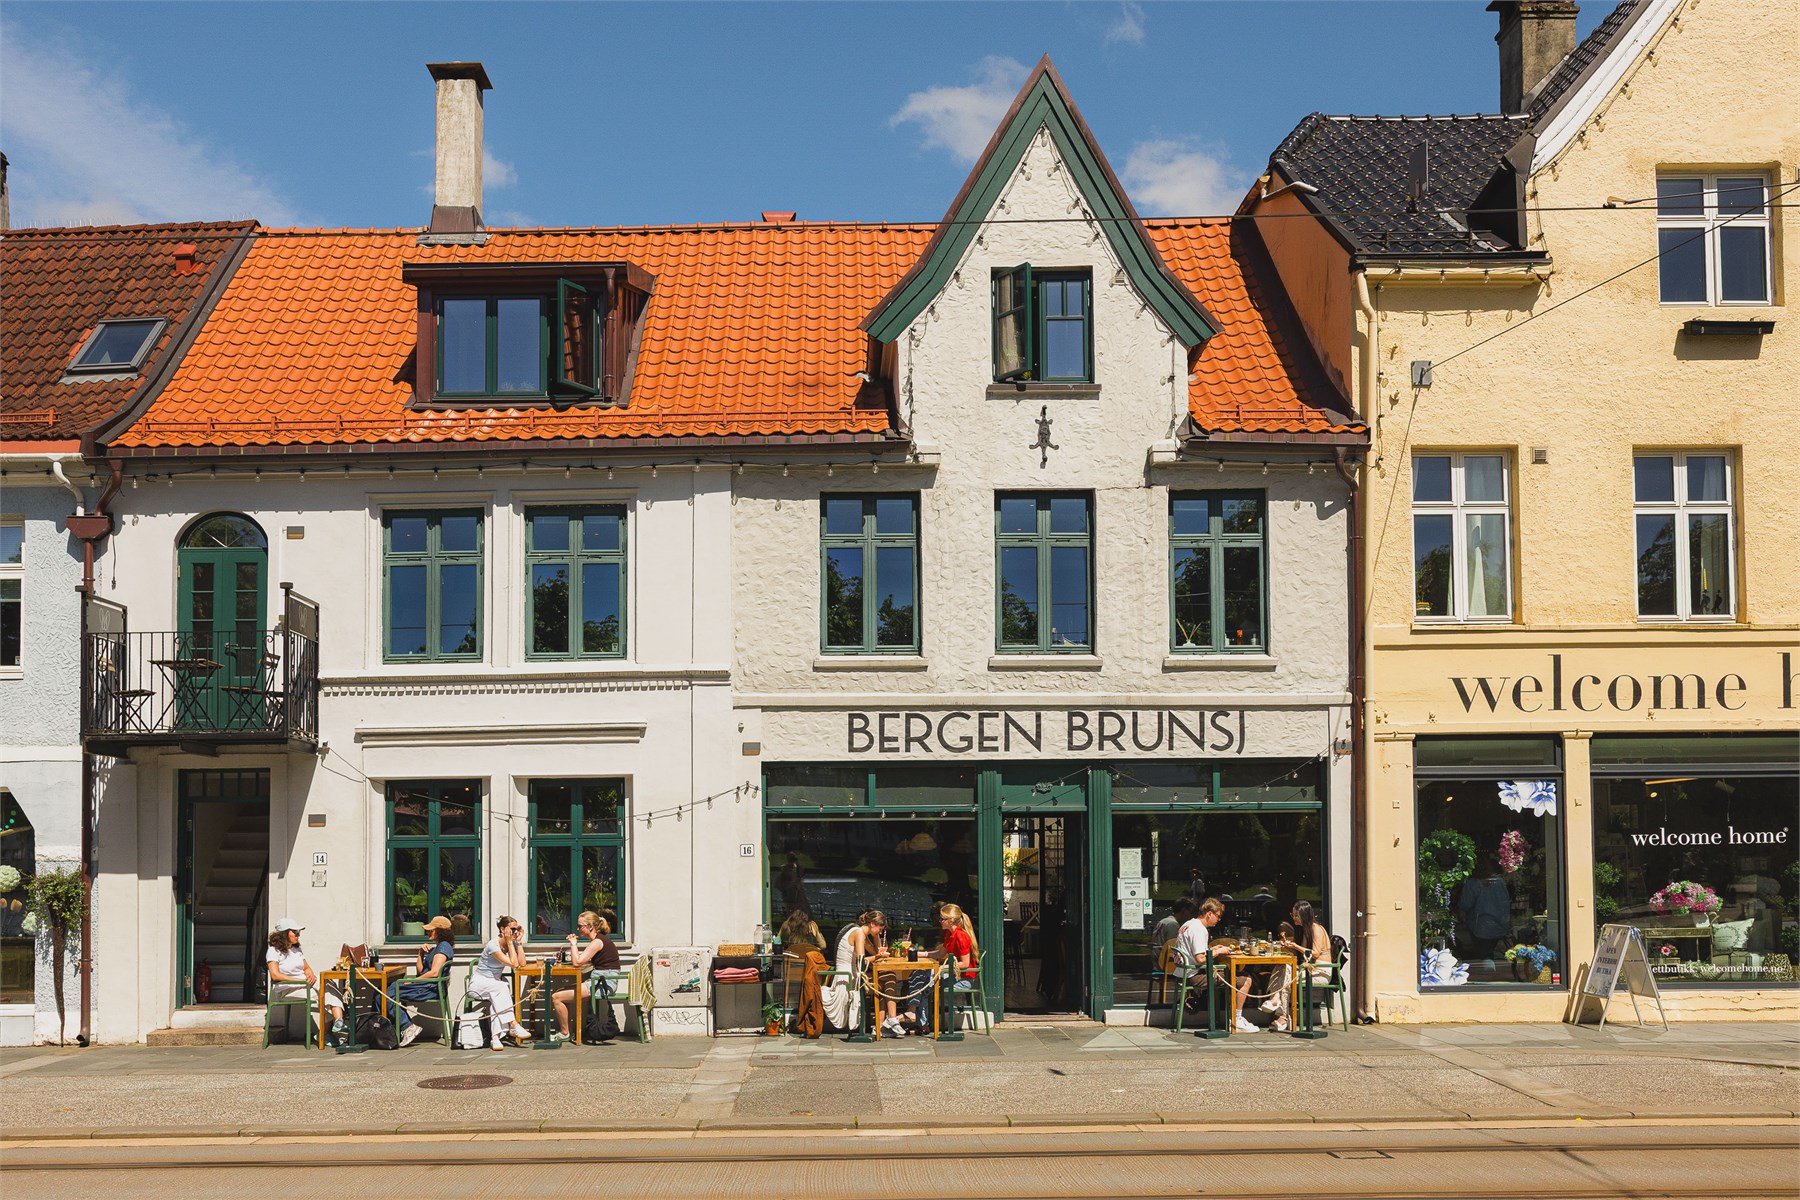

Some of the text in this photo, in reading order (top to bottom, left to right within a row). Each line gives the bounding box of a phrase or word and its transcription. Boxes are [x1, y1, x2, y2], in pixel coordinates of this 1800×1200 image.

[1447, 653, 1747, 713] welcome
[847, 710, 1246, 755] BERGEN BRUNSJ
[1631, 827, 1722, 847] welcome
[315, 855, 325, 863] 14
[743, 846, 752, 855] 16
